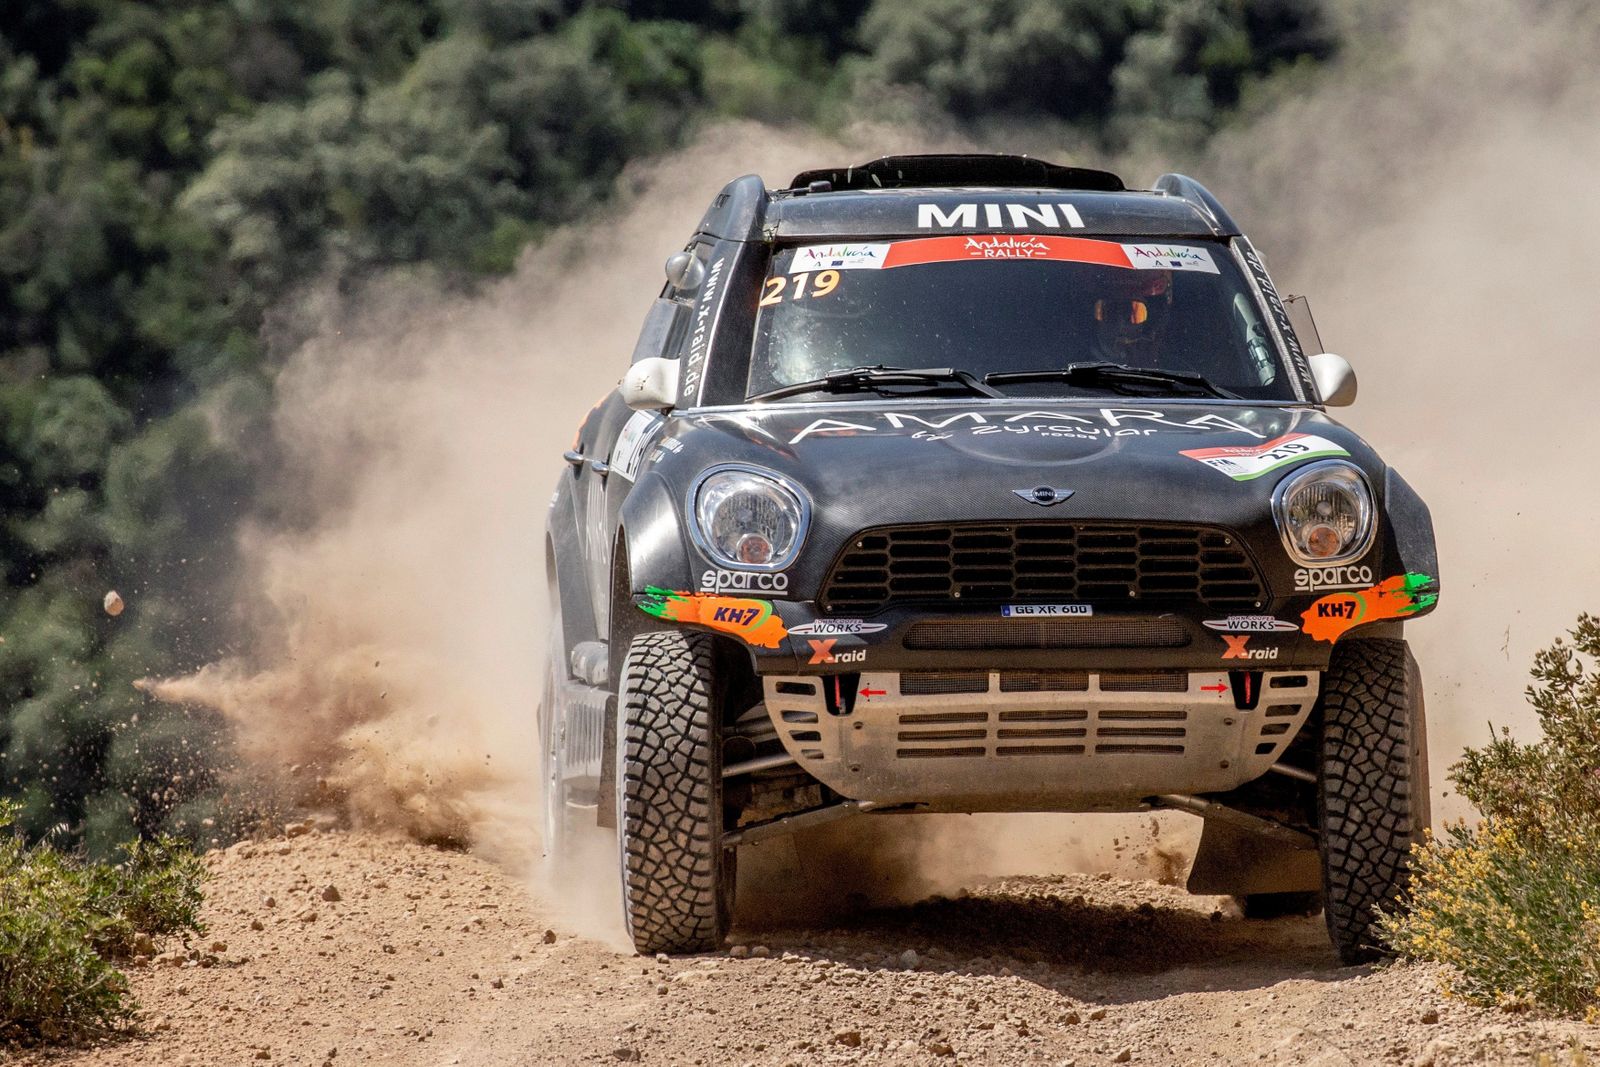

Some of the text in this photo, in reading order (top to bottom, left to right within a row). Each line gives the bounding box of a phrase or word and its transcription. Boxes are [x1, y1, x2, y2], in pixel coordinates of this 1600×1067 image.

[917, 203, 1085, 228] MINI
[984, 248, 1034, 258] RALLY
[760, 269, 840, 307] 219
[684, 257, 724, 397] www.x-raid.de
[788, 407, 1267, 445] AMARA
[1258, 443, 1310, 460] 219
[1035, 490, 1055, 498] MINI
[701, 570, 789, 594] sparco
[1294, 566, 1373, 592] sparco
[1015, 605, 1087, 614] GG XR 600
[814, 623, 862, 633] WORKS
[1227, 620, 1274, 630] WORKS
